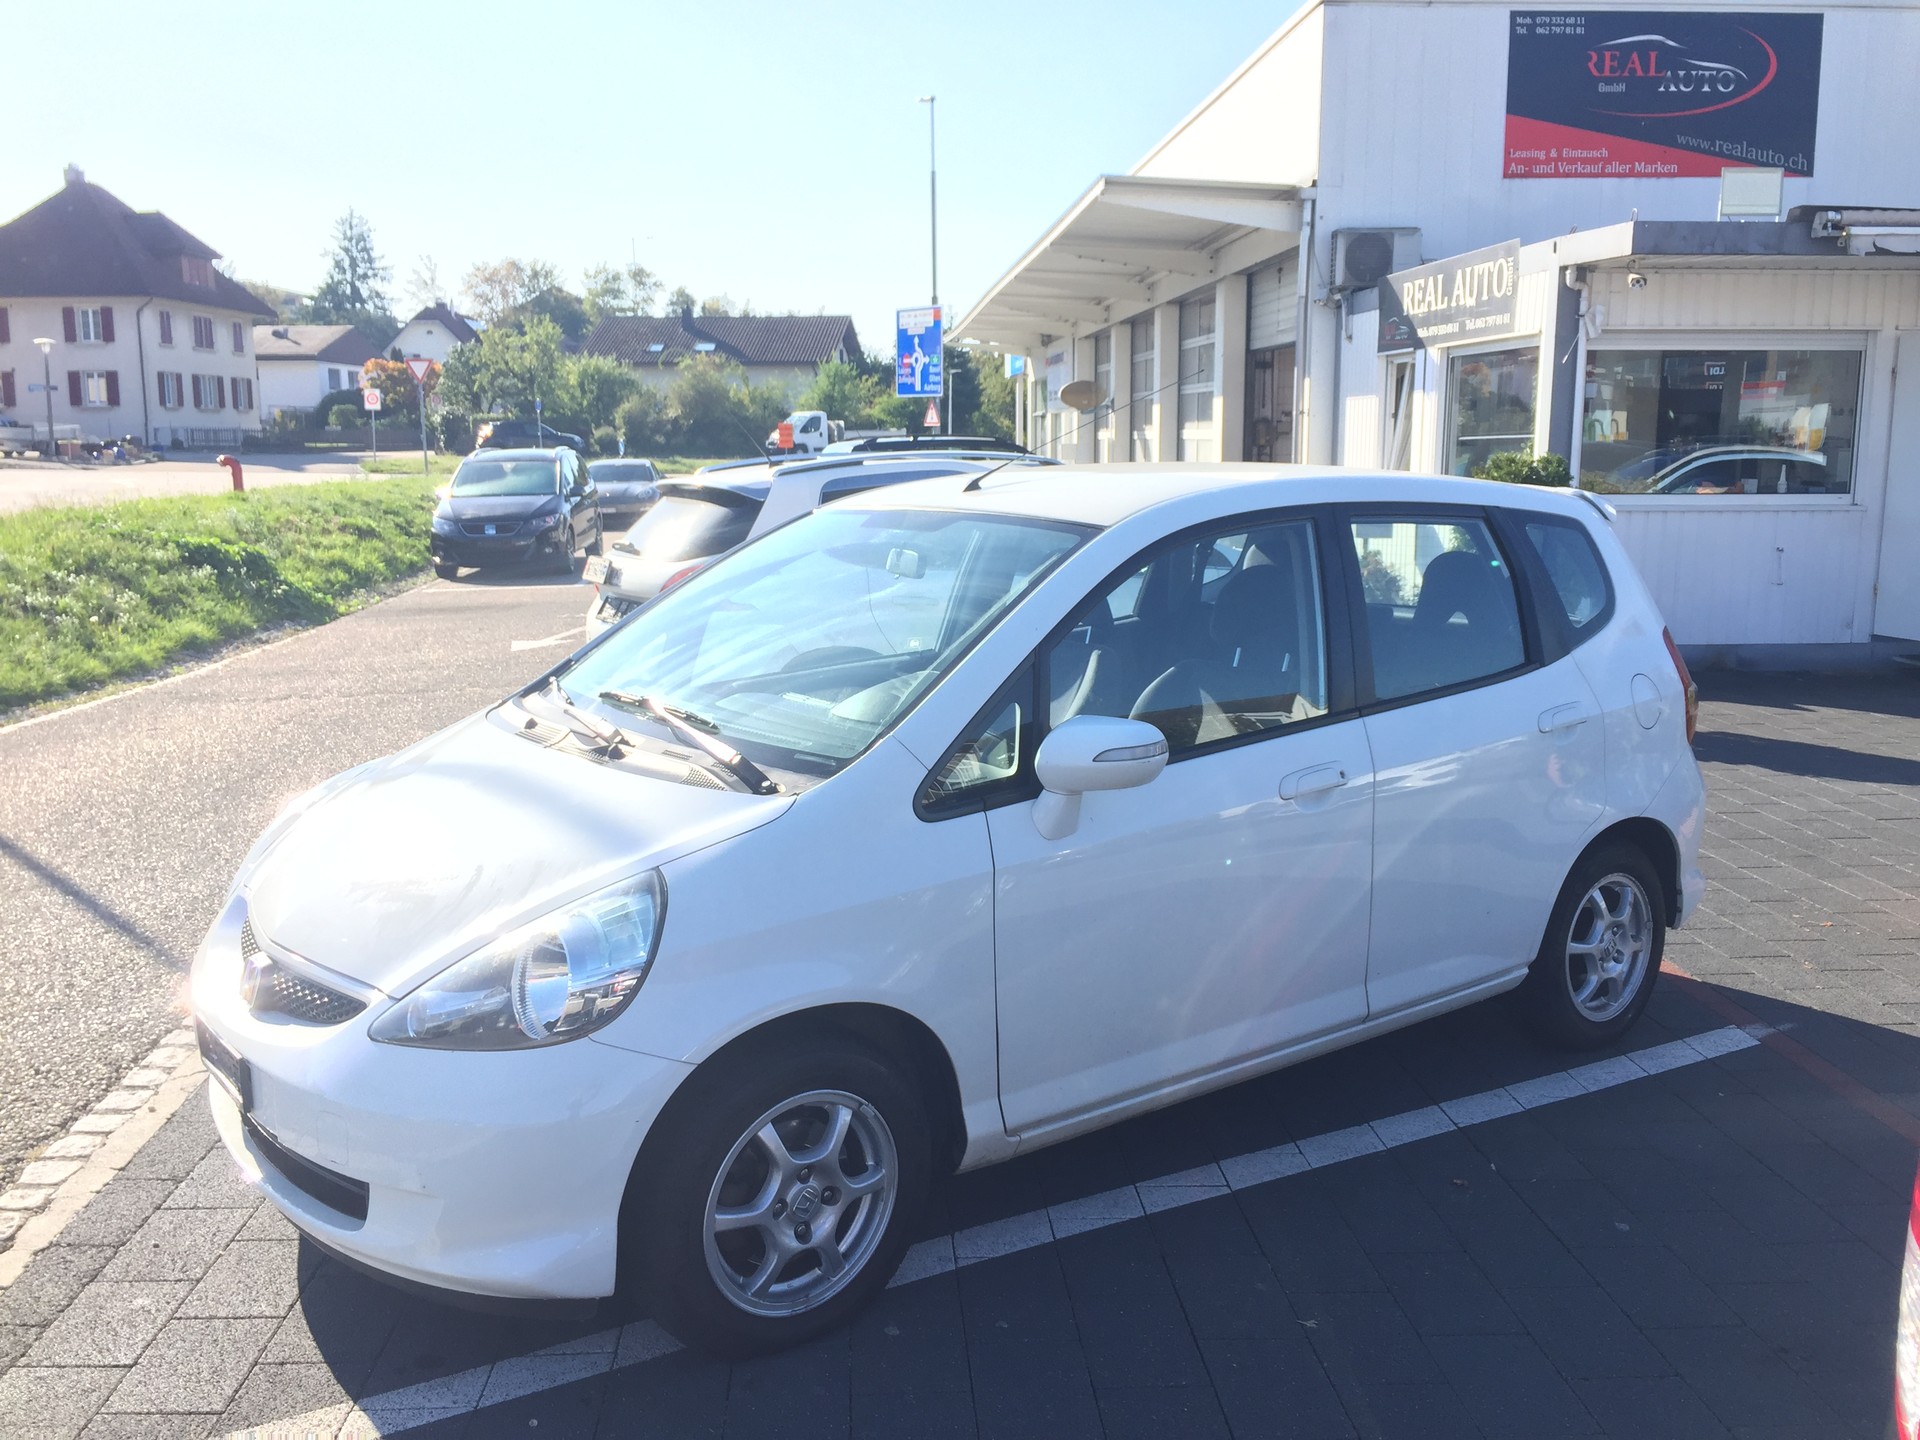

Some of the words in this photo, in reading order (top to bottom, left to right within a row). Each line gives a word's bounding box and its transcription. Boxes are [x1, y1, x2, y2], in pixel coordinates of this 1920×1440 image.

[1536, 16, 1550, 24] 079
[1551, 16, 1564, 24] 332
[1577, 16, 1585, 24] 11
[1536, 26, 1550, 34] 062
[1551, 26, 1564, 34] 797
[1566, 26, 1574, 34] 81
[1576, 26, 1585, 34] 81
[1587, 51, 1667, 78] REAL
[1658, 70, 1737, 92] AUTO
[1598, 83, 1626, 93] GmbH
[1510, 148, 1546, 160] Leasing
[1550, 149, 1558, 158] &
[1563, 148, 1608, 158] Eintausch
[1676, 132, 1808, 171] www.realauto.ch
[1508, 163, 1530, 174] An-
[1532, 163, 1555, 173] und
[1558, 162, 1602, 173] Verkauf
[1605, 162, 1630, 173] aller
[1634, 162, 1678, 173] Marken
[1402, 274, 1448, 316] REAL
[1451, 257, 1508, 307] AUTO
